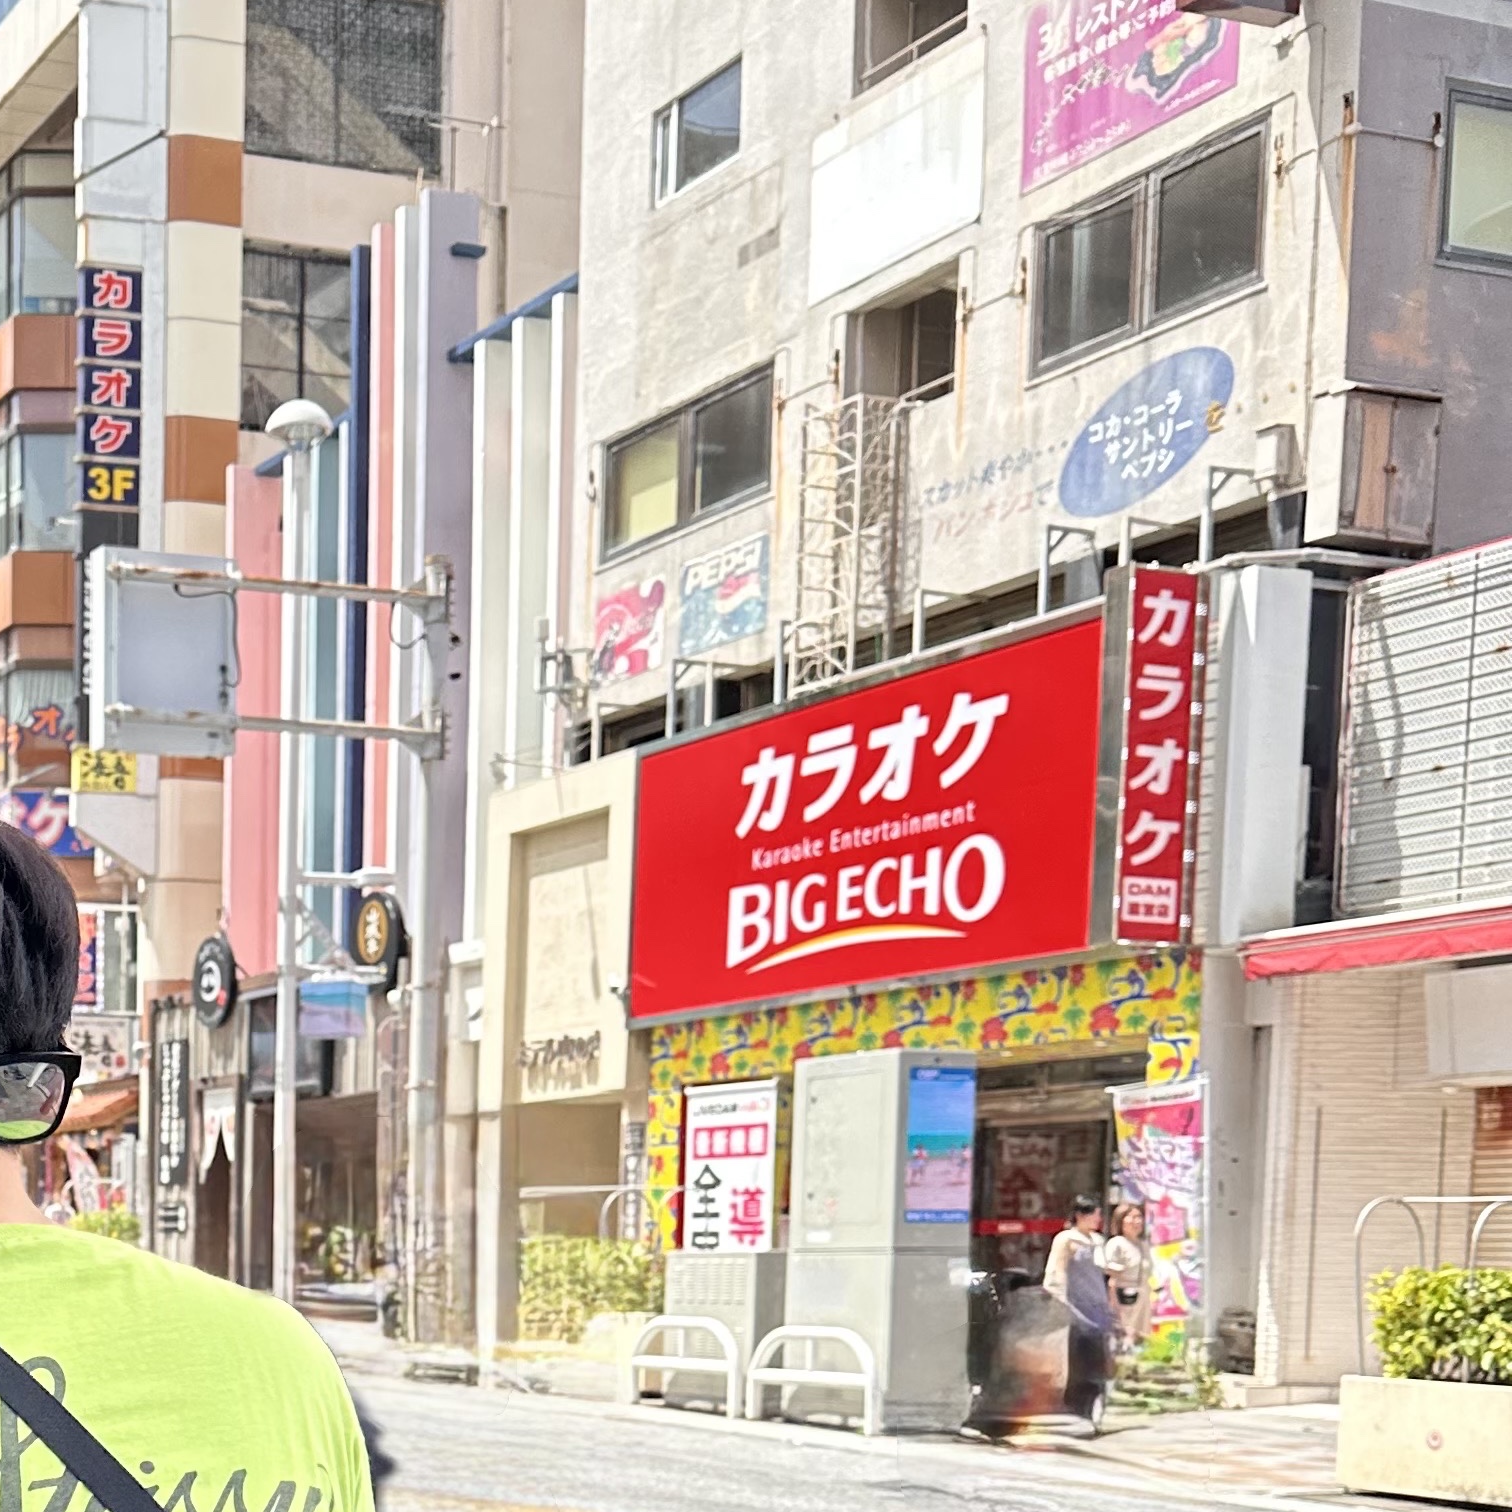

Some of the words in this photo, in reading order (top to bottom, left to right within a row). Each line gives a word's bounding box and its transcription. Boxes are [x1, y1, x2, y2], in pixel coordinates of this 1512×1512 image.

[90, 270, 133, 453] カラオケ
[1088, 389, 1183, 444] コカ・コーラ
[1104, 418, 1194, 464] サントリー
[88, 467, 136, 501] 3F
[684, 540, 763, 595] PEPSI
[1126, 588, 1191, 866] カラオケ
[735, 692, 1009, 839] カラオケ
[751, 838, 824, 871] Karaoke
[829, 800, 977, 854] Entertainment
[725, 873, 827, 969] BIG
[836, 833, 1006, 923] ECHO
